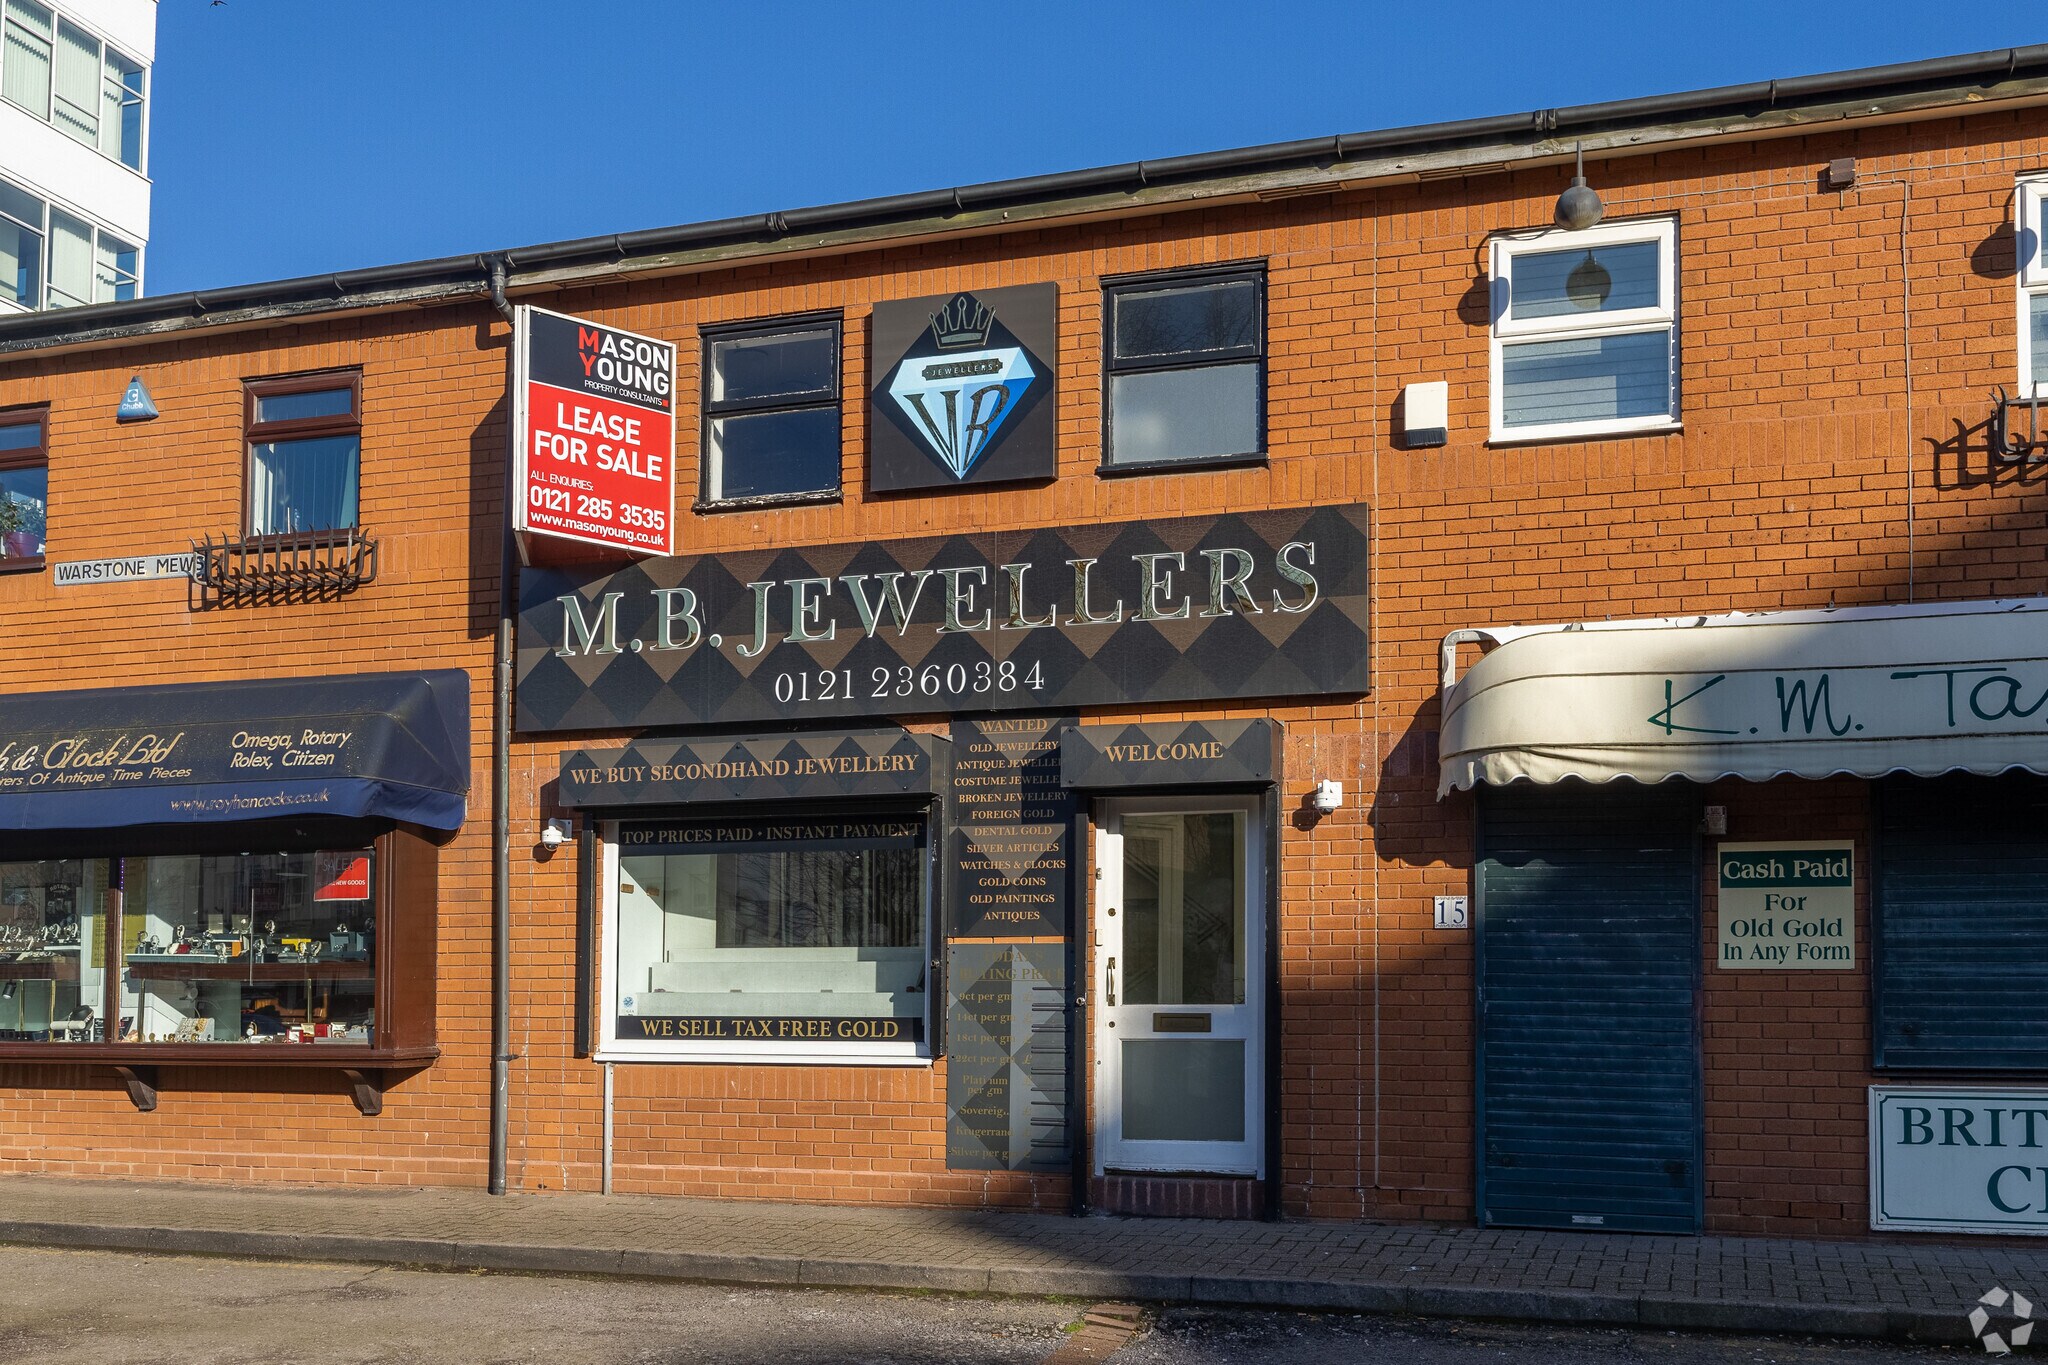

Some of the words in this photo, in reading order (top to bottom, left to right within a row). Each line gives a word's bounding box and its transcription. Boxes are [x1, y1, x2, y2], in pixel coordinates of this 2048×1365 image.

[578, 326, 669, 371] MASON
[578, 352, 669, 395] YOUNG
[931, 363, 994, 377] JEWELLERS
[584, 379, 618, 395] PROPERTY
[619, 388, 662, 406] CONSULTANTS
[121, 401, 144, 410] Chubb
[557, 402, 641, 446] LEASE
[534, 429, 588, 466] FOR
[596, 444, 663, 481] SALE
[530, 470, 547, 483] ALL
[549, 474, 594, 491] ENQUIRIES:
[530, 485, 570, 510] 0121
[577, 494, 613, 520] 285
[619, 503, 665, 530] 3535
[530, 511, 665, 546] www.masonyoung.co.uk
[58, 560, 145, 580] WARSTONE
[156, 556, 205, 575] MEWS
[775, 669, 854, 702] 0121
[871, 659, 1046, 698] 2360384
[1890, 667, 2048, 728] Ta
[980, 719, 1048, 732] WANTED
[231, 731, 293, 750] Omega,
[300, 729, 352, 748] Rotary
[970, 744, 992, 753] OLD
[994, 741, 1059, 752] JEWELLERY
[11, 745, 39, 771] &
[43, 736, 126, 769] Clock
[120, 732, 185, 766] Ltd
[230, 751, 274, 770] Rolex,
[281, 750, 335, 767] Citizen
[1105, 741, 1224, 762] WELCOME
[570, 767, 602, 785] WE
[606, 766, 645, 784] BUY
[650, 759, 790, 782] SECONDHAND
[794, 754, 920, 775] JEWELLERY
[956, 760, 1005, 771] ANTIQUE
[29, 772, 51, 786] Of
[53, 771, 105, 786] Antique
[112, 769, 144, 781] Time
[148, 766, 192, 779] Pieces
[954, 776, 1007, 786] COSTUME
[1009, 775, 1061, 785] JEWELLE
[958, 793, 1001, 803] BROKEN
[1003, 791, 1069, 802] JEWELLERY
[972, 809, 1021, 820] FOREIGN
[1023, 809, 1055, 818] GOLD
[622, 830, 655, 845] TOP
[658, 828, 713, 843] PRICES
[716, 827, 753, 842] PAID
[766, 824, 838, 840] INSTANT
[842, 823, 922, 838] PAYMENT
[974, 826, 1018, 837] DENTAL
[1020, 826, 1053, 835] GOLD
[967, 843, 1006, 853] SILVER
[1007, 842, 1059, 852] ARTICLES
[960, 861, 1011, 870] WATCHES
[1013, 861, 1021, 869] &
[1024, 859, 1066, 869] CLOCKS
[1723, 859, 1785, 879] Cash
[1792, 857, 1848, 878] Paid
[979, 877, 1010, 886] GOLD
[1013, 876, 1046, 886] COINS
[970, 894, 992, 903] OLD
[995, 893, 1055, 903] PAINTINGS
[1764, 893, 1808, 911] For
[984, 911, 1040, 922] ANTIQUES
[1437, 900, 1465, 925] 15
[1730, 917, 1774, 938] Old
[1783, 917, 1844, 938] Gold
[1723, 943, 1743, 960] In
[1750, 943, 1790, 965] Any
[1796, 943, 1851, 961] Form
[958, 991, 976, 1001] 9ct
[977, 992, 994, 1003] per
[640, 1020, 673, 1036] WE
[678, 1020, 727, 1037] SELL
[731, 1020, 772, 1037] TAX
[778, 1020, 832, 1037] FREE
[837, 1020, 899, 1038] GOLD
[980, 1014, 997, 1024] per
[956, 1033, 977, 1042] 18ct
[980, 1035, 997, 1045] per
[955, 1054, 977, 1064] 22ct
[980, 1055, 997, 1066] per
[1022, 1054, 1032, 1065] £
[967, 1086, 984, 1096] per
[986, 1086, 1003, 1097] gm
[1896, 1106, 2048, 1148] BRIT
[951, 1147, 979, 1157] Silver
[982, 1149, 999, 1160] per
